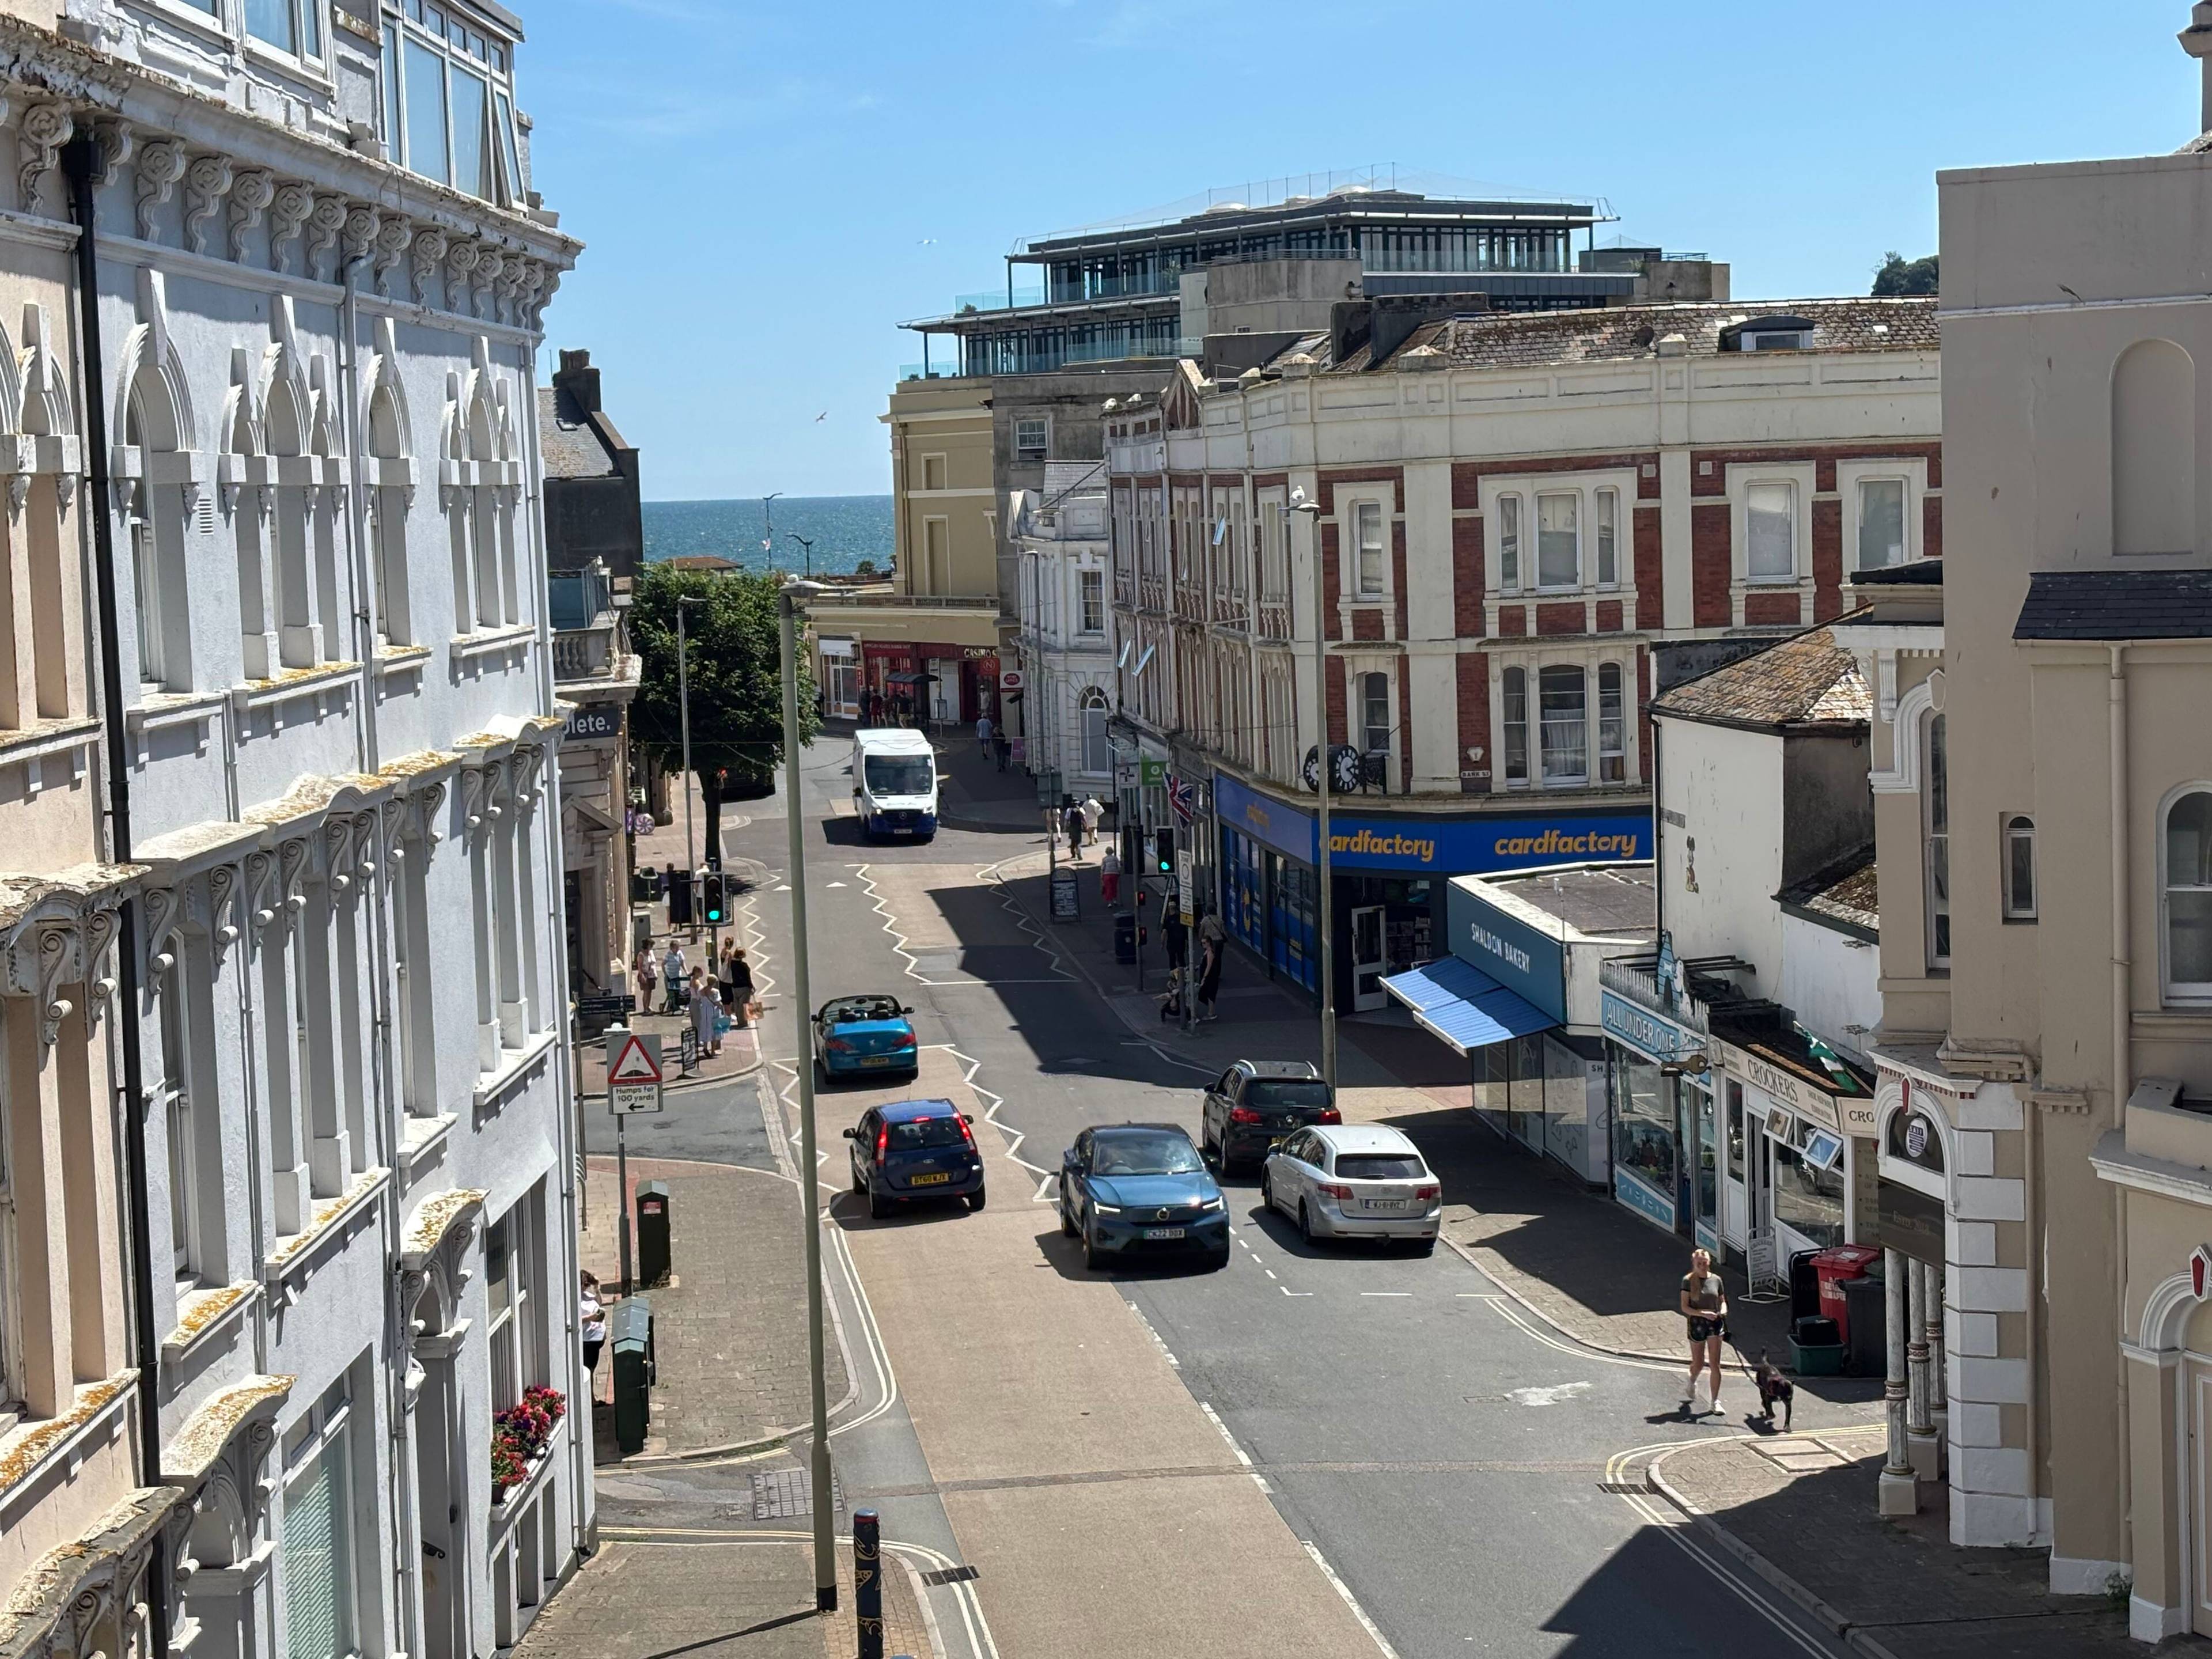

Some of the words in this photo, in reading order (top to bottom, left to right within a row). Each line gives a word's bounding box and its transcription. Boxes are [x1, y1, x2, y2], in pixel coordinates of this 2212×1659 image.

[1330, 830, 1434, 862] ardfactory
[1494, 830, 1637, 858] cardfactory
[1471, 922, 1502, 957] SHALDON
[1505, 941, 1530, 974] BAKERY
[1607, 1001, 1622, 1028] ALL
[1624, 1012, 1655, 1047] UNDER
[1656, 1028, 1676, 1059] ONE
[634, 1094, 655, 1102] yards
[1747, 1059, 1798, 1103] CROCKERS
